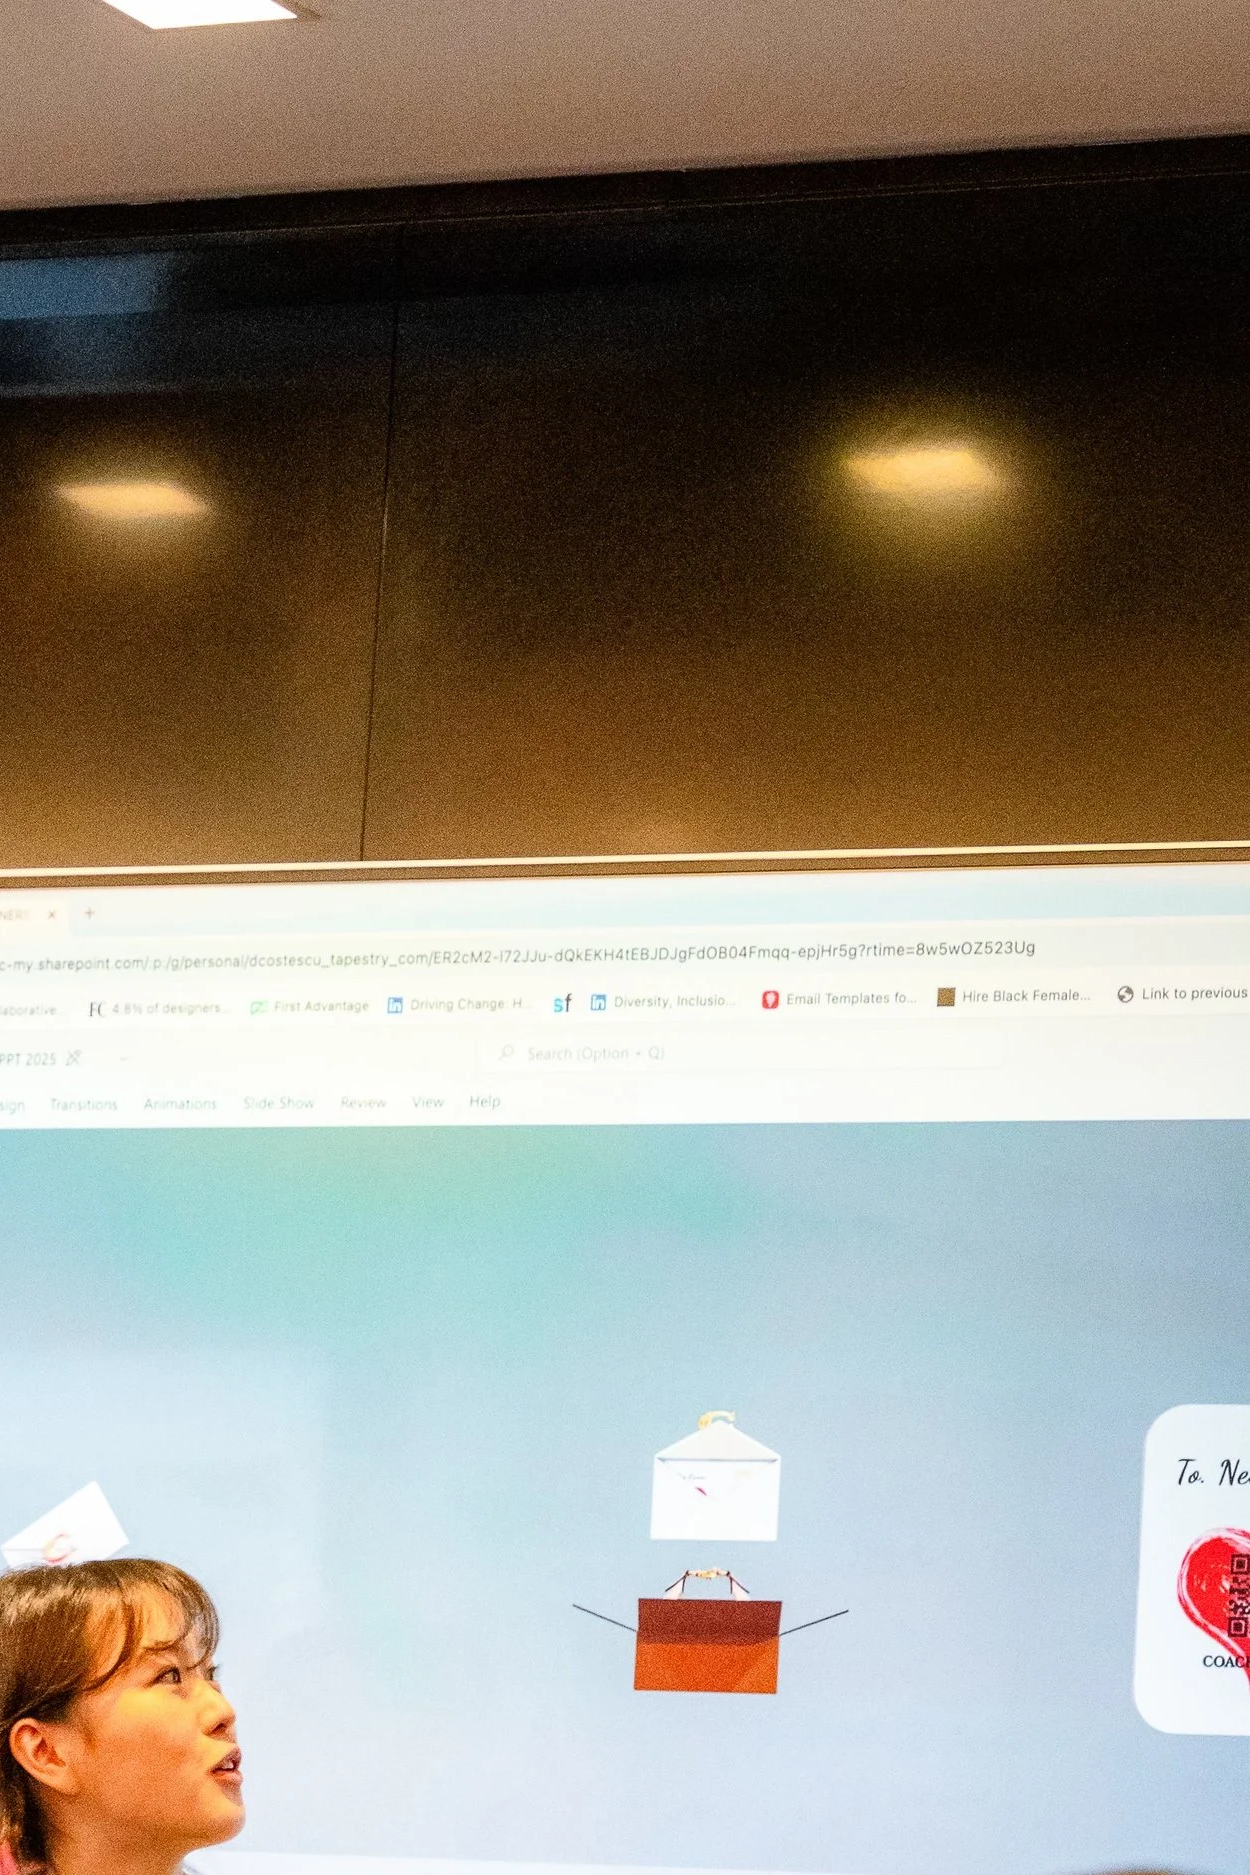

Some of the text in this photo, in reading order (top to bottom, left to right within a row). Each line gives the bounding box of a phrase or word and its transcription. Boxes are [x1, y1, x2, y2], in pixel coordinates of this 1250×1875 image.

[786, 992, 820, 1005] Email
[825, 991, 890, 1007] Templates
[962, 989, 988, 1002] Hire
[993, 988, 1029, 1002] Black
[1142, 986, 1249, 1001] Link to previous
[146, 1001, 159, 1014] of
[273, 998, 369, 1014] First Advantage
[410, 996, 454, 1013] Driving
[614, 995, 673, 1011] Diversity,
[26, 1052, 57, 1066] 2025
[527, 1046, 572, 1061] Search
[50, 1097, 118, 1112] Transitions
[143, 1097, 218, 1111] Animations
[243, 1096, 275, 1110] Slide
[279, 1095, 315, 1110] Show
[341, 1095, 387, 1109] Review
[411, 1094, 445, 1109] View
[469, 1094, 502, 1111] Help
[1177, 1458, 1250, 1486] To. Ne
